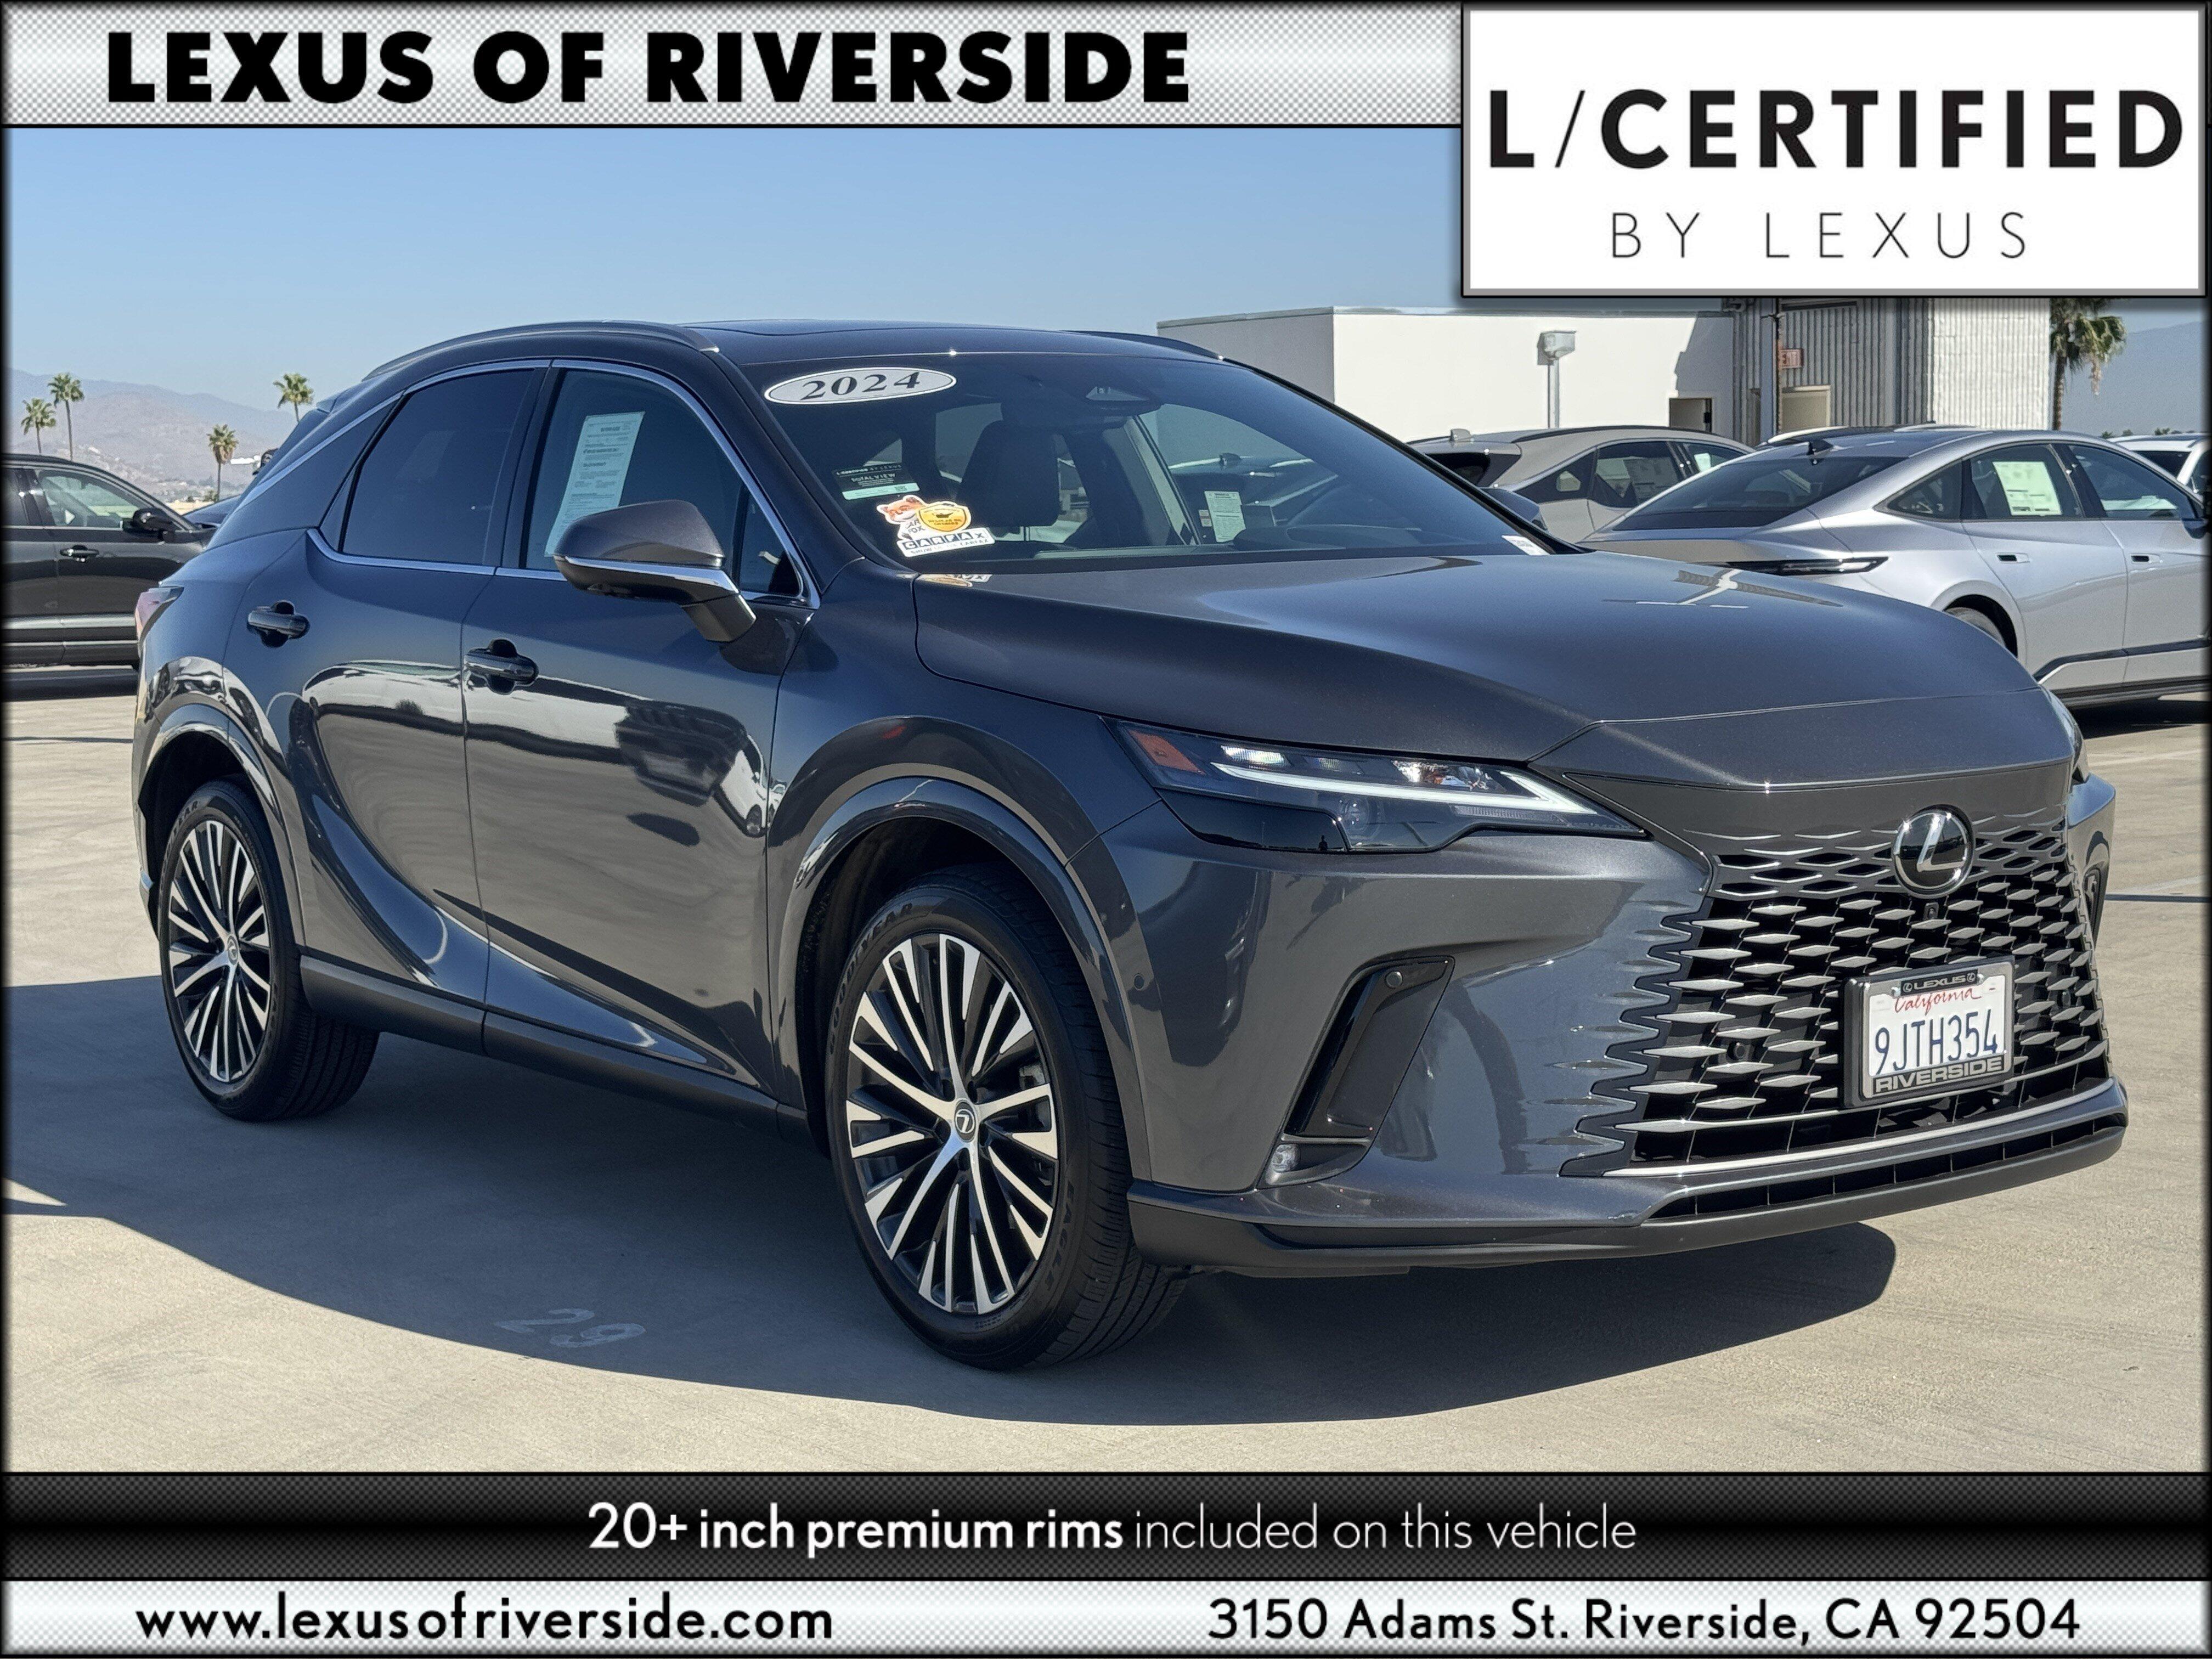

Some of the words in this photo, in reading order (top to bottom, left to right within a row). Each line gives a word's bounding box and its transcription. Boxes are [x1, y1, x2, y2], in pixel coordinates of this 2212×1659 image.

[800, 371, 920, 400] 2024
[902, 532, 986, 550] CARFAX
[1914, 976, 1966, 990] LEXUS
[1894, 986, 1982, 1016] California
[1875, 1008, 1998, 1075] 9JTH354
[1875, 1057, 2002, 1093] RIVERSIDE
